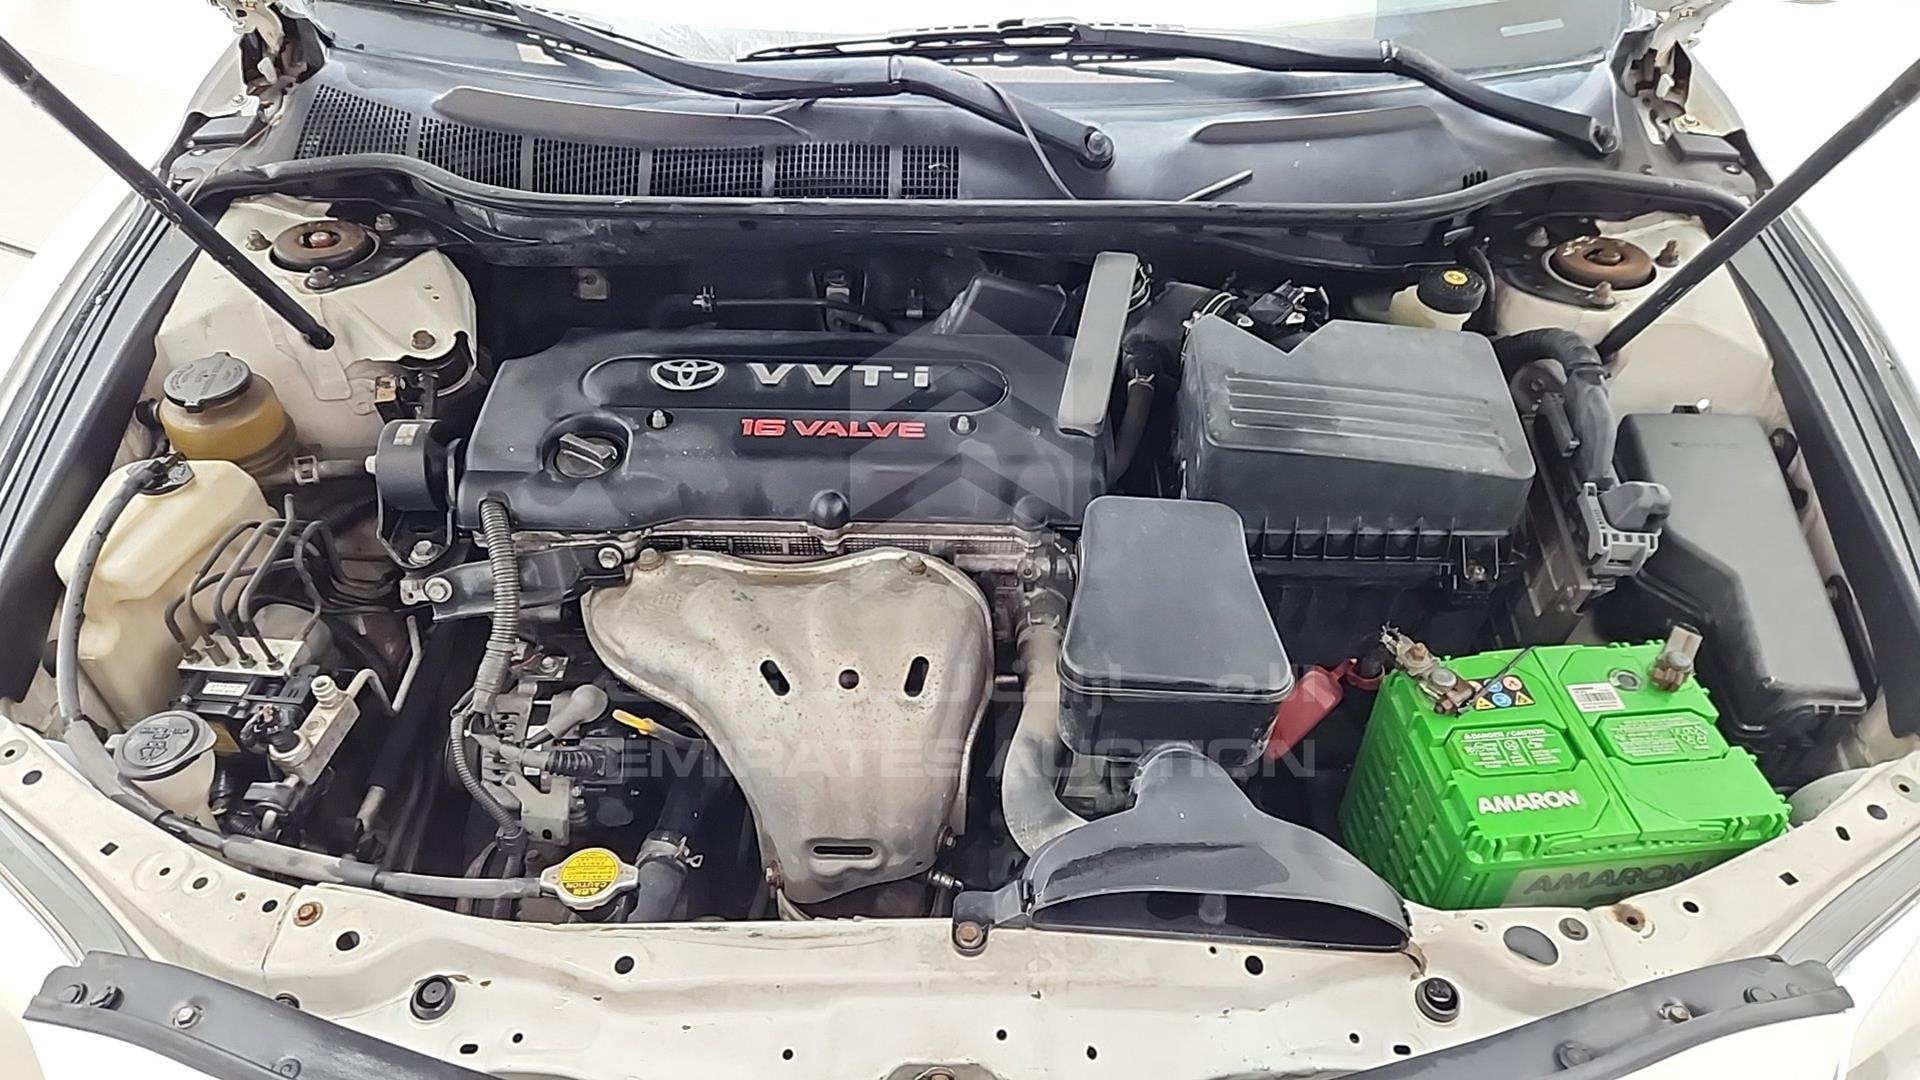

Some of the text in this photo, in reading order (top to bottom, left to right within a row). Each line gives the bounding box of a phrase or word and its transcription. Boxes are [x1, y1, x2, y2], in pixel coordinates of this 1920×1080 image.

[748, 363, 930, 388] VVT-i
[741, 417, 927, 439] 16 VALVE
[1478, 790, 1581, 815] AMARON
[566, 881, 608, 889] CAUTION
[1524, 861, 1703, 894] AMARON
